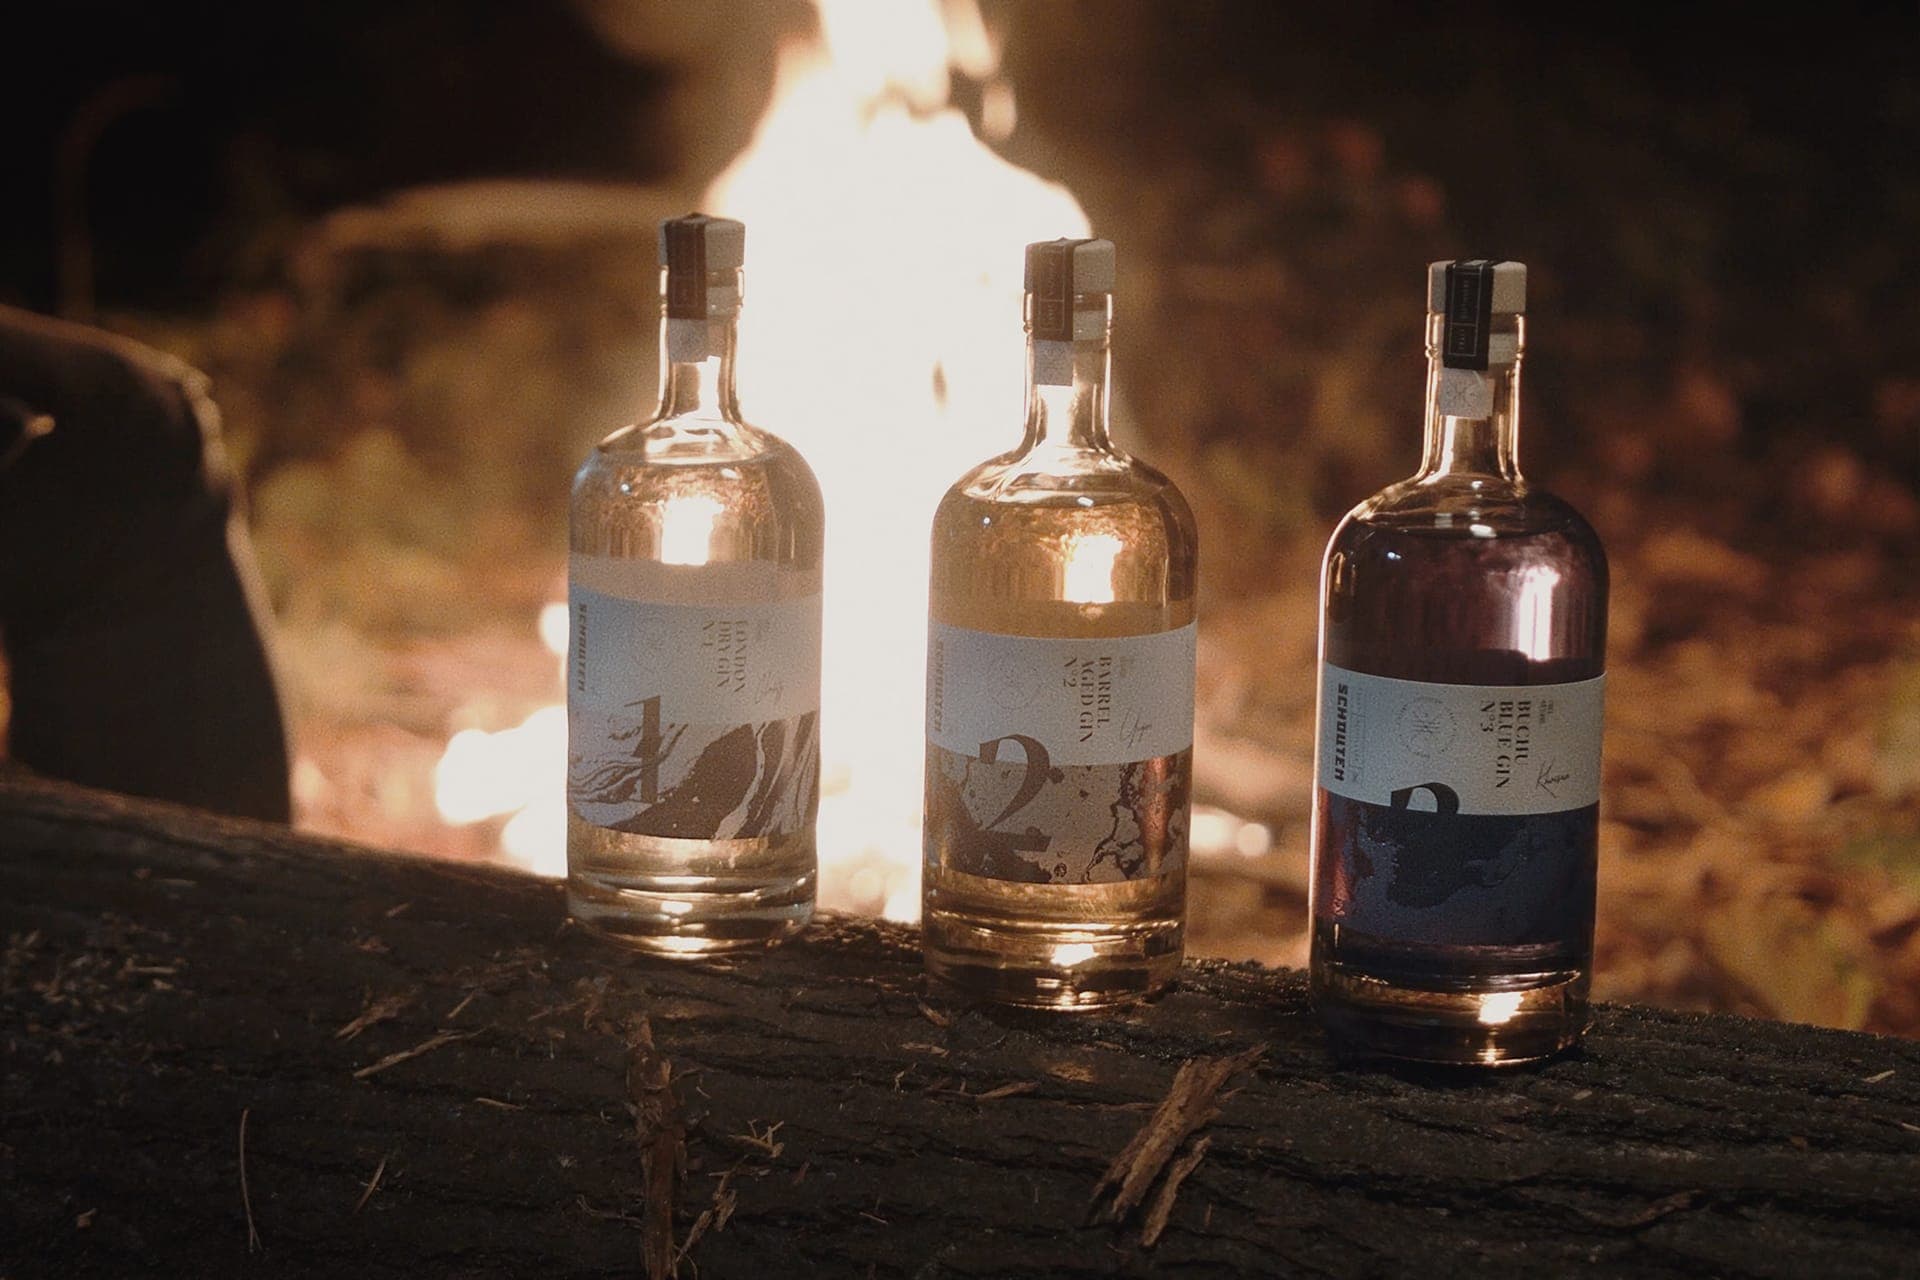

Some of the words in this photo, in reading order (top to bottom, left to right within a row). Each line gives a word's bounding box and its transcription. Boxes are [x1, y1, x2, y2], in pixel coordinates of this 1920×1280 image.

[717, 620, 732, 653] DRY
[732, 620, 748, 693] LONDON
[717, 657, 731, 689] GIN
[1080, 660, 1095, 707] AGED
[1097, 656, 1112, 728] BARREL
[1079, 711, 1093, 743] GIN
[1334, 682, 1349, 782] SCHOUTEN
[1498, 700, 1514, 749] BLUE
[1515, 700, 1531, 763] BUCHU
[979, 733, 1052, 853] 2
[1496, 753, 1511, 788] GIN
